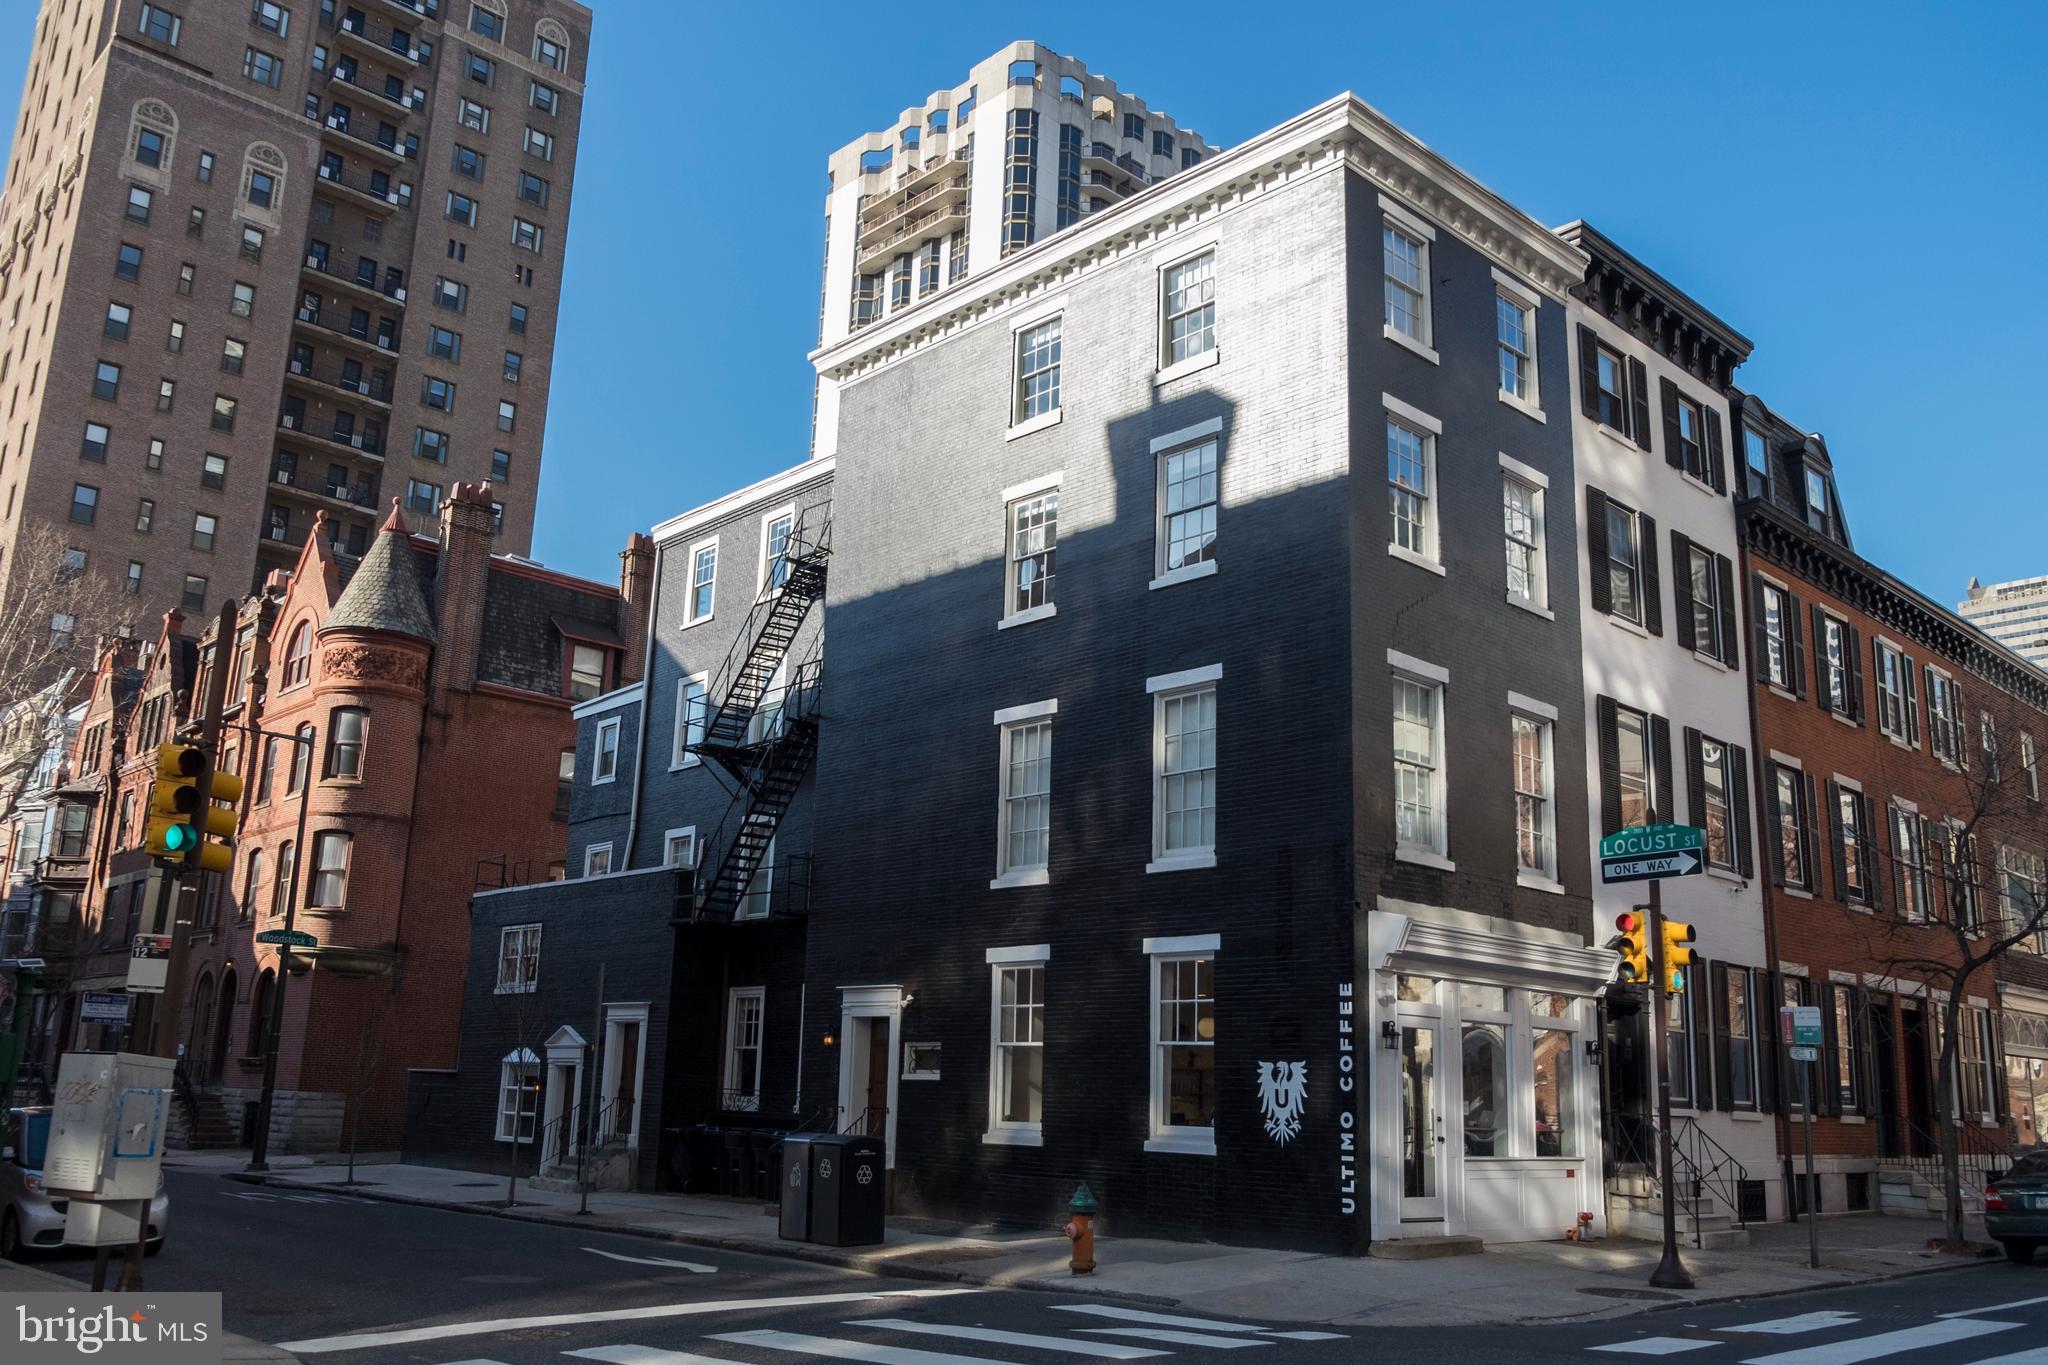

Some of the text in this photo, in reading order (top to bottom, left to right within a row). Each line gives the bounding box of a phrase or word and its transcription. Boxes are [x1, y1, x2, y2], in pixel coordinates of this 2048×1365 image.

[1603, 833, 1697, 856] LOCUST ST
[1614, 859, 1673, 875] ONE WAY
[261, 932, 306, 946] Woodstock
[134, 947, 149, 958] 12
[1274, 1088, 1290, 1109] U
[1339, 982, 1356, 1214] ULTIMO COFFEE
